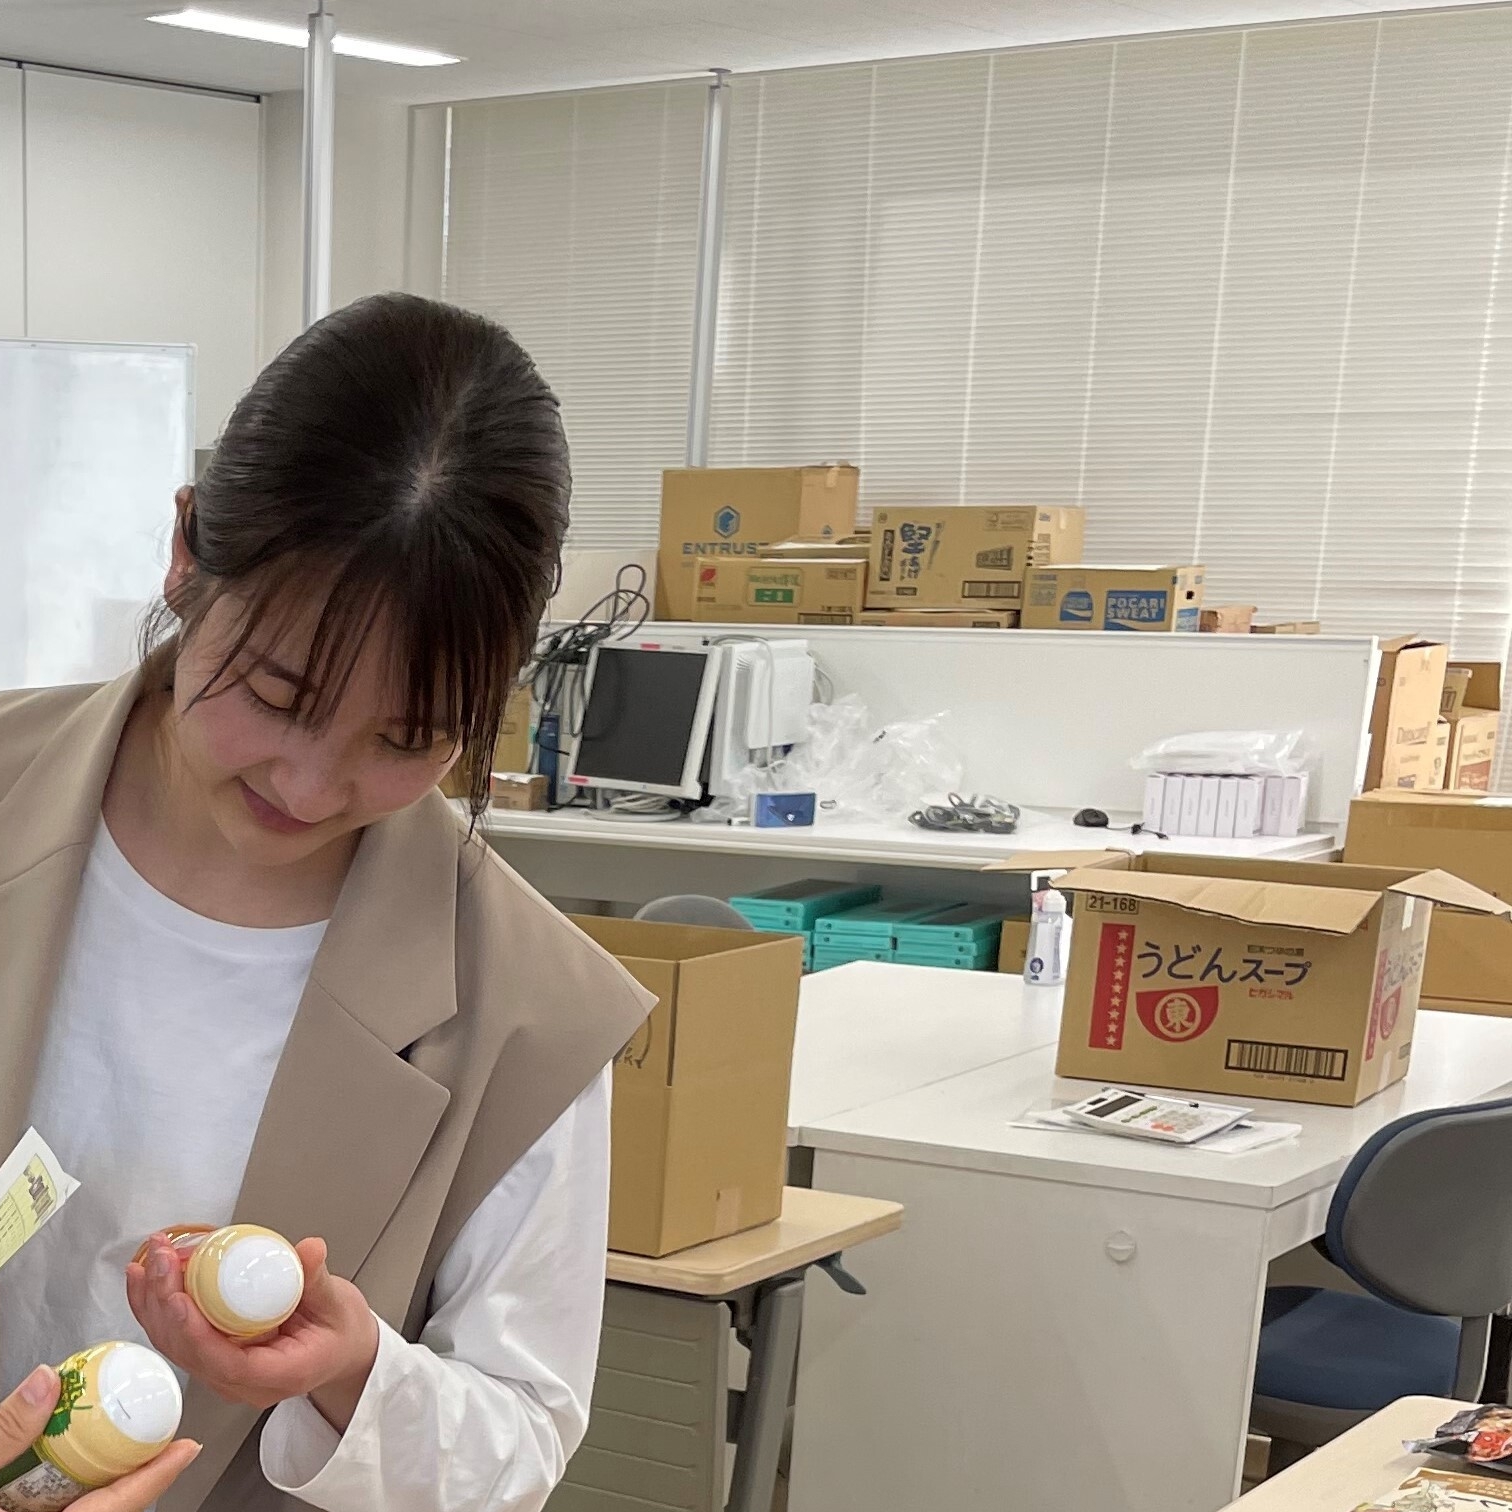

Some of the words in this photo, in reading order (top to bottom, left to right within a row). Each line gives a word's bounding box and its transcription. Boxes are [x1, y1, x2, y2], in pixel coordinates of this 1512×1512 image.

[1107, 597, 1165, 609] POCARI
[1106, 608, 1159, 619] SWEAT
[1089, 895, 1137, 912] 21-168
[1137, 941, 1313, 986] うどんスープ
